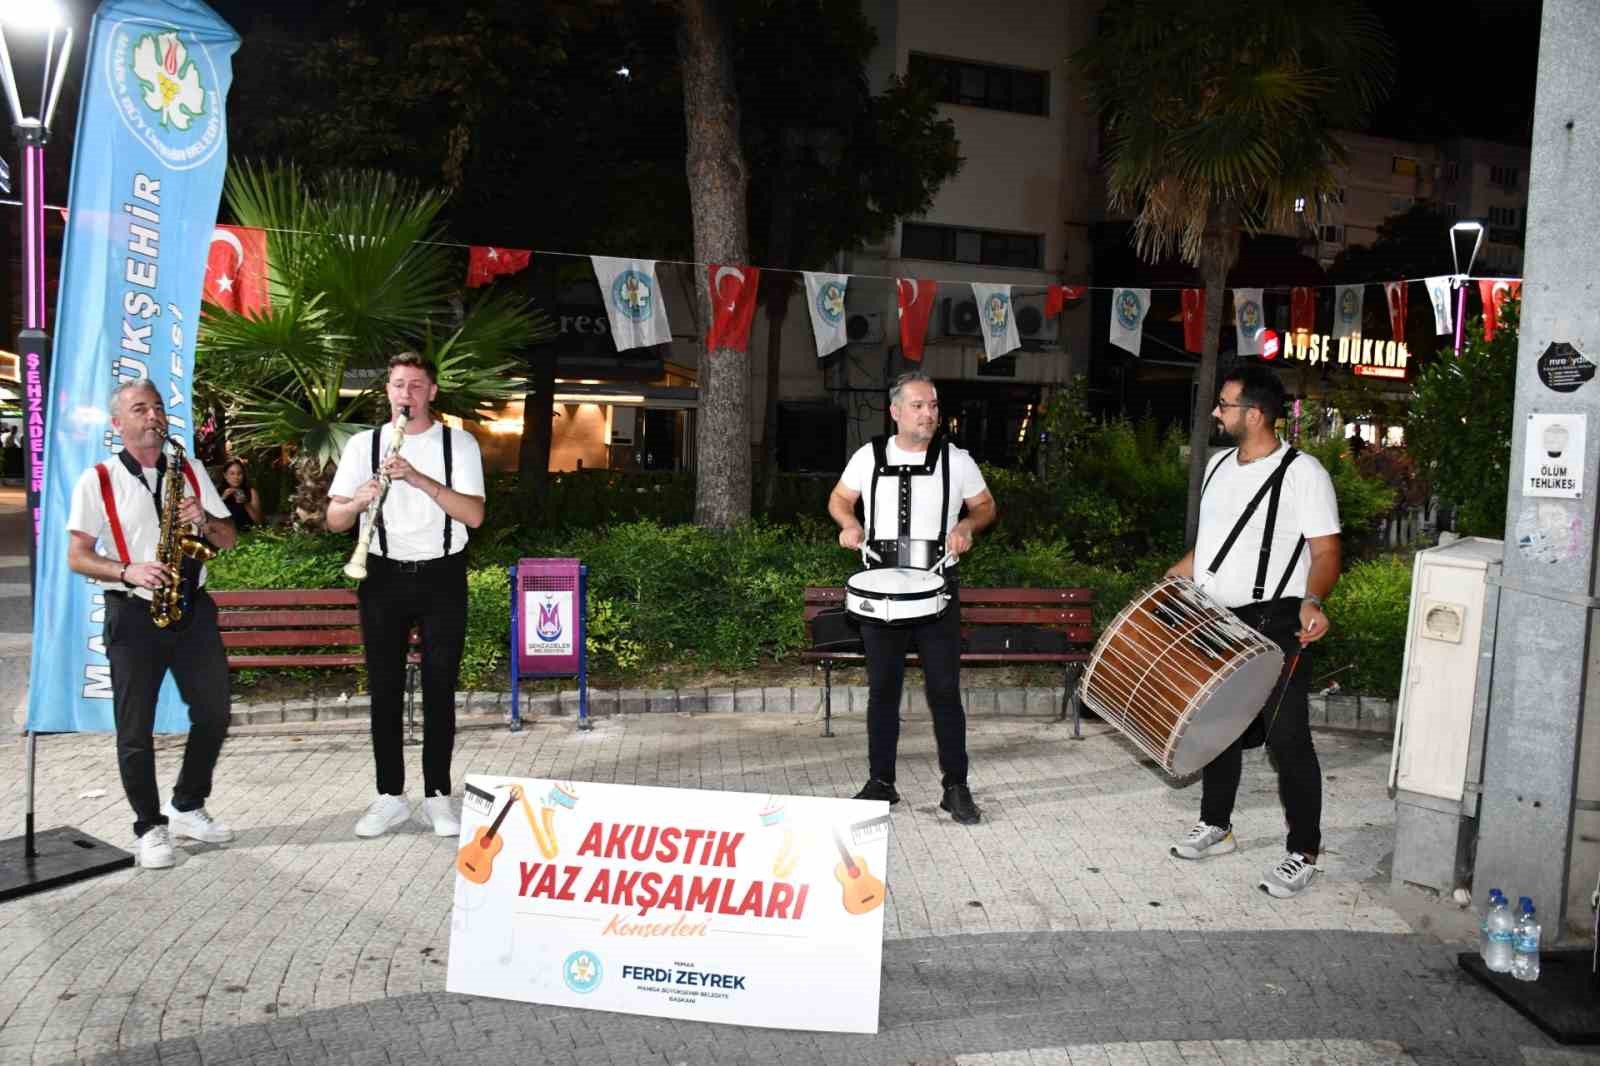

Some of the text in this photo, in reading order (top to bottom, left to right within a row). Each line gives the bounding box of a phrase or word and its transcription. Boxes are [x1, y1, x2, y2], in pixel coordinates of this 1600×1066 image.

[559, 315, 607, 335] res
[1540, 463, 1567, 477] ÖLÜM
[518, 861, 810, 920] YAZ AKŞAMLARI
[602, 913, 709, 938] Konserleri
[675, 969, 747, 990] ZEYREK
